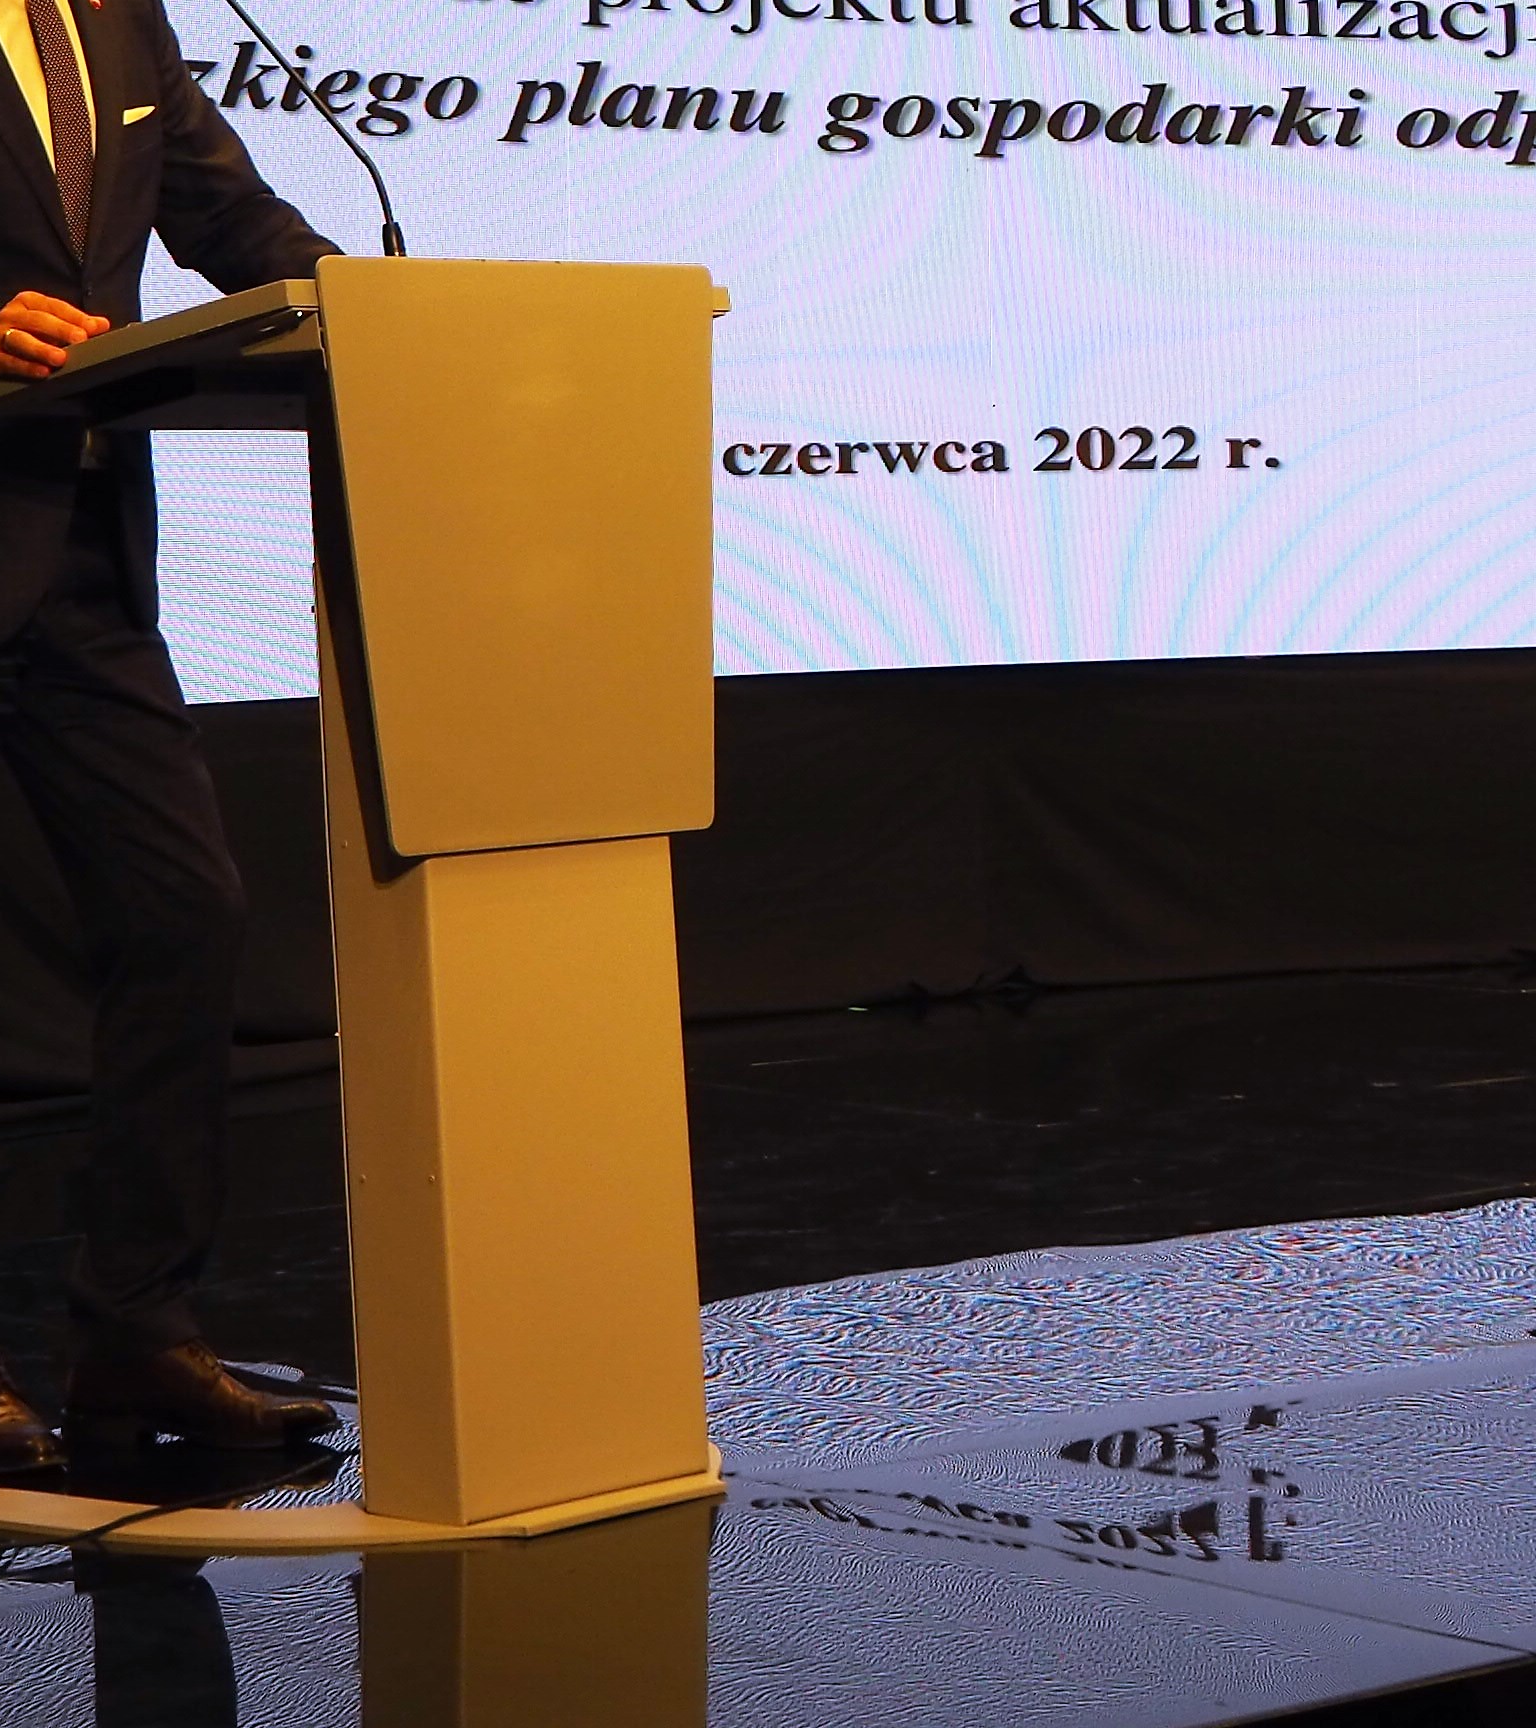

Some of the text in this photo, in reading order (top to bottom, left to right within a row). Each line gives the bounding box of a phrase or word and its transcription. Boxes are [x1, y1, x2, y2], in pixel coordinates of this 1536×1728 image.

[498, 60, 785, 144] planu
[817, 83, 1367, 160] gospodarki
[722, 425, 1280, 477] czerwca 2022 r.
